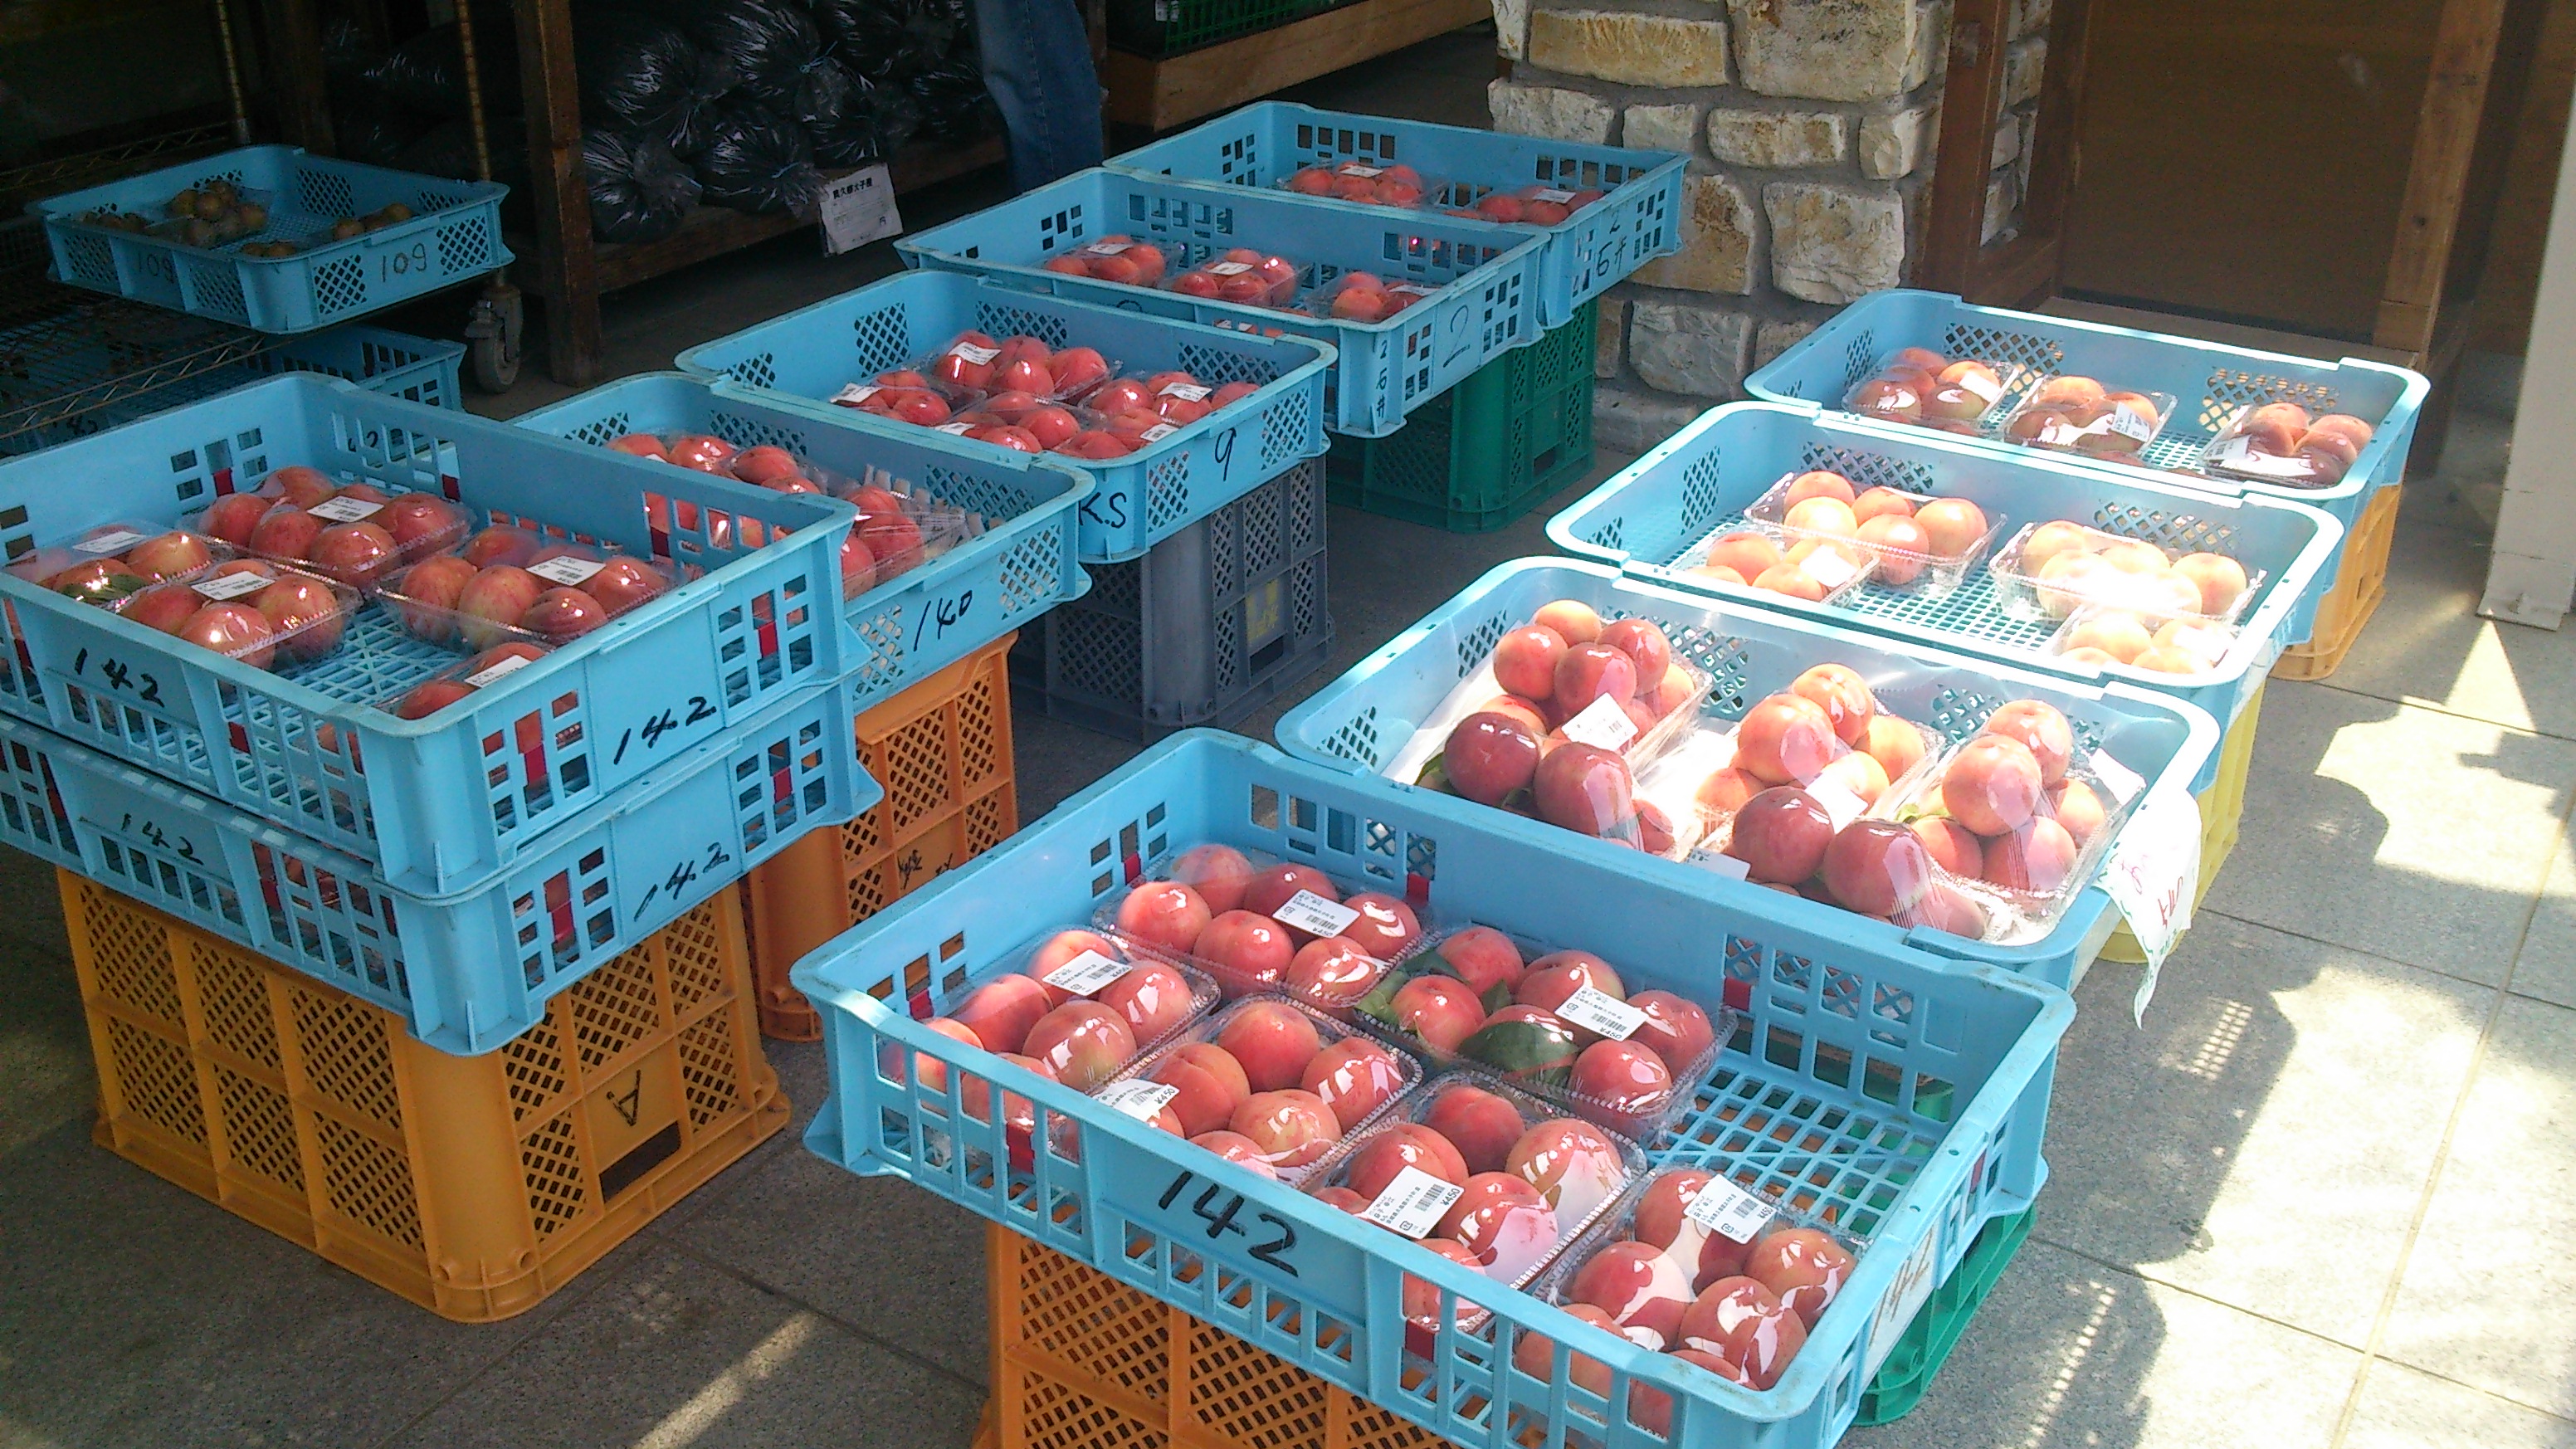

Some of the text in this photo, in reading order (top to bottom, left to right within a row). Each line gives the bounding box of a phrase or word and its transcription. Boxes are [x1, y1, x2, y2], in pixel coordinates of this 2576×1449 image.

[382, 243, 427, 283] 109
[1443, 305, 1471, 368] 2
[1214, 427, 1237, 482] 9
[913, 590, 973, 651] 140
[73, 647, 164, 708] 142
[612, 696, 716, 765] 142
[122, 813, 202, 865] 142
[633, 842, 731, 921] 142
[1158, 1170, 1300, 1278] 142
[1440, 1188, 1461, 1206] ¥450
